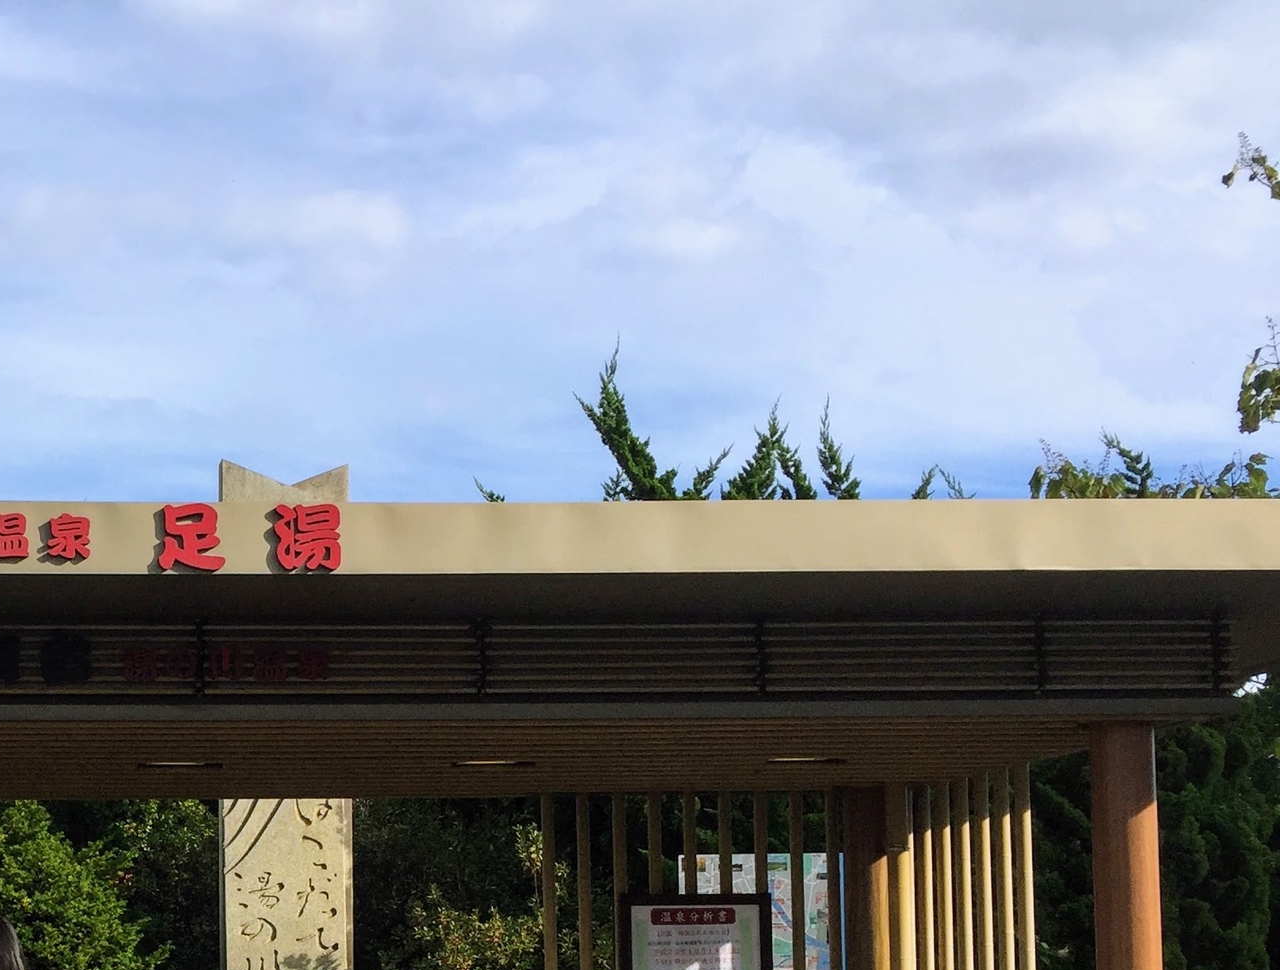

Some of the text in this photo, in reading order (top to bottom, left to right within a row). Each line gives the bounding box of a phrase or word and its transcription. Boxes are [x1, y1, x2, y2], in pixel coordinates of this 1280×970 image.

[158, 503, 342, 571] 足湯
[660, 911, 728, 923] 温泉分析書
